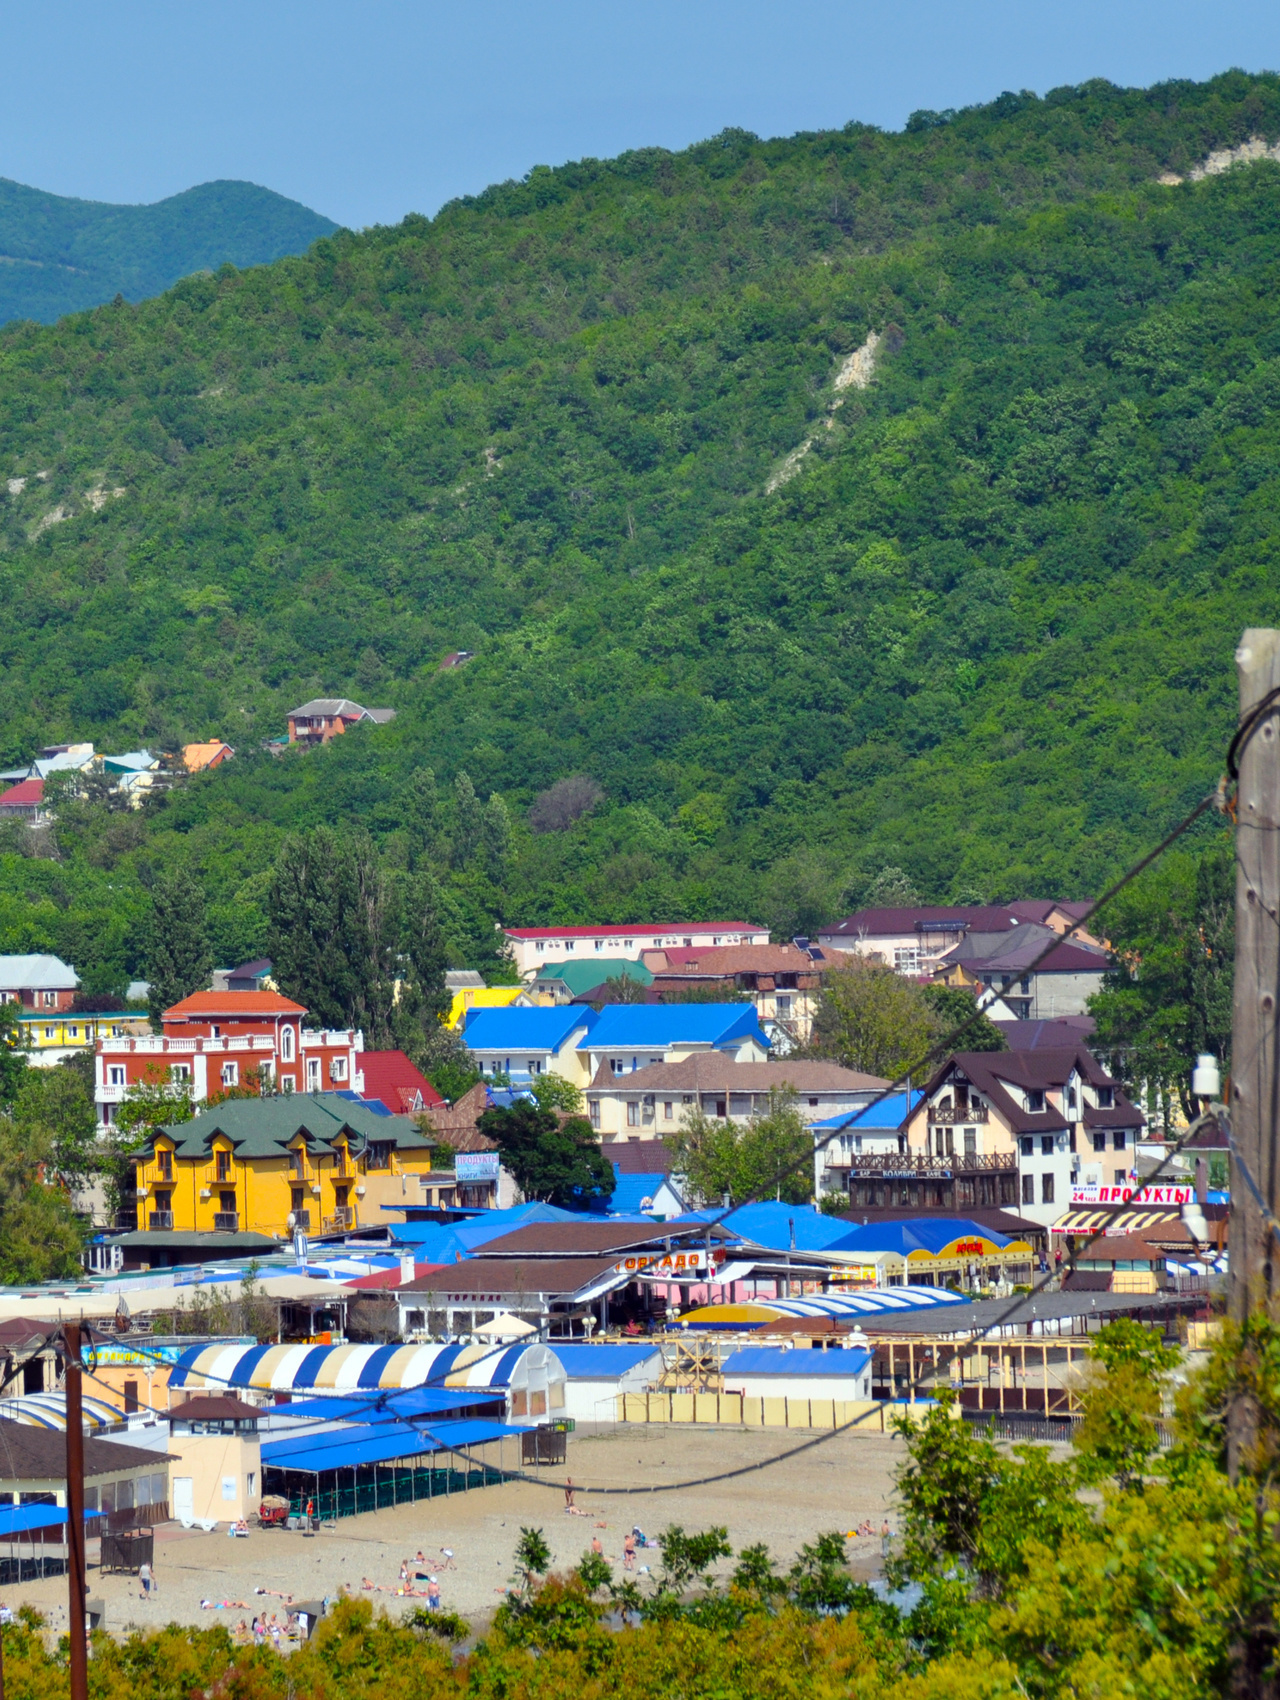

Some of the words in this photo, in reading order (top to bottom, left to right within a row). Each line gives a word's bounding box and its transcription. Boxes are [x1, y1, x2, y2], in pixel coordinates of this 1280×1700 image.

[457, 1154, 499, 1165] ПРОДУКТЫ
[1072, 1192, 1084, 1201] 24
[616, 1253, 700, 1271] ОРАДО
[447, 1294, 501, 1302] ТОРНАДО
